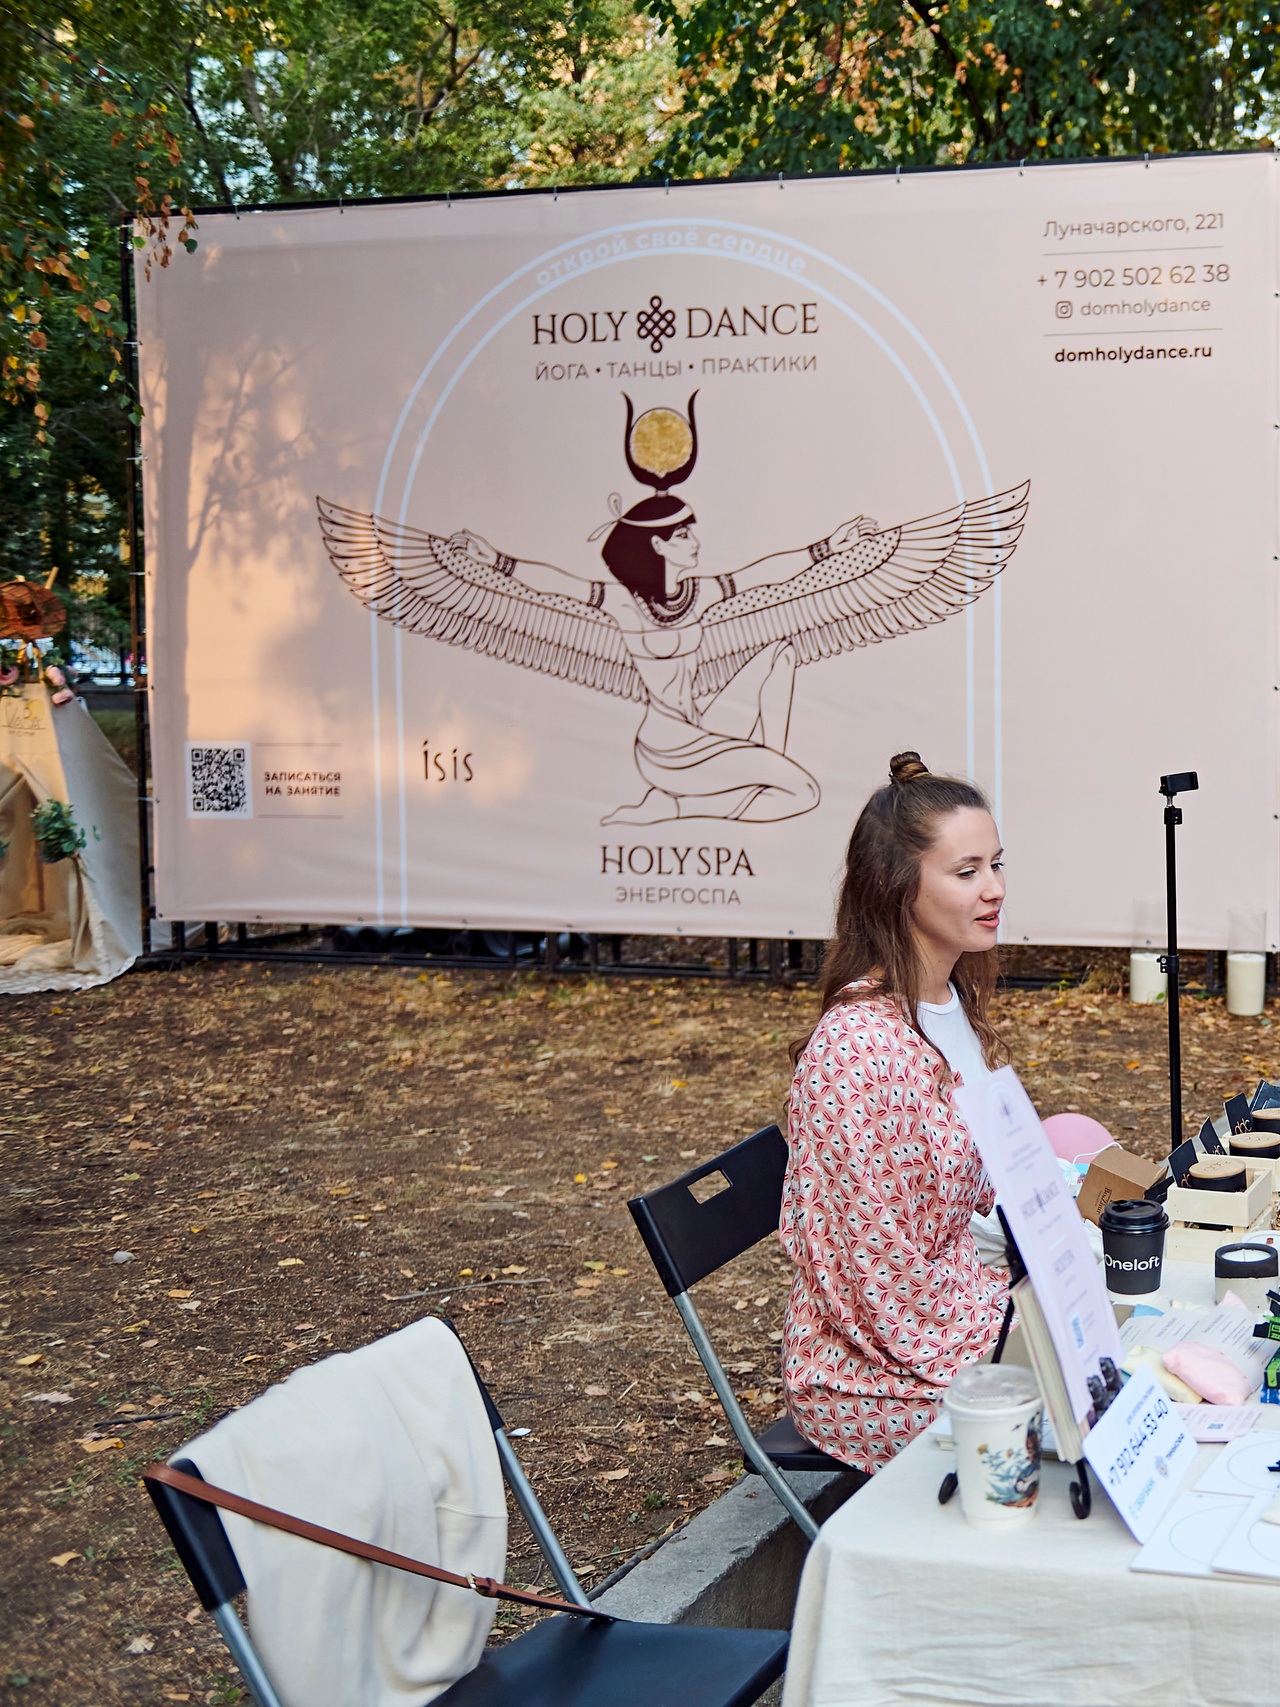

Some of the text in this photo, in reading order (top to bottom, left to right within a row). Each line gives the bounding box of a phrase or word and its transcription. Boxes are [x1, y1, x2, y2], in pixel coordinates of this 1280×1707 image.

[1043, 212, 1225, 240] Луначарского, 221
[535, 226, 806, 286] открой своё сердце
[1054, 270, 1068, 288] 7
[1074, 268, 1116, 288] 902
[1122, 266, 1163, 286] 502
[1170, 265, 1196, 284] 62
[1202, 263, 1231, 283] 38
[1080, 297, 1211, 317] domholydance
[532, 301, 820, 346] HOLY DANCE
[1054, 344, 1213, 364] domholydance.ru
[534, 354, 818, 382] ЙОГА ТАНЦЫ ПРАКТИКИ
[264, 771, 342, 782] ЗАПИСАТЬСЯ
[265, 785, 341, 797] НА ЗАНЯТИЕ
[615, 886, 742, 905] ЭНЕРГОСПА
[1104, 1252, 1160, 1272] Oneloft
[1119, 1448, 1136, 1477] 912
[1131, 1427, 1148, 1457] 644
[1144, 1412, 1159, 1435] 53
[1155, 1398, 1169, 1420] 40
